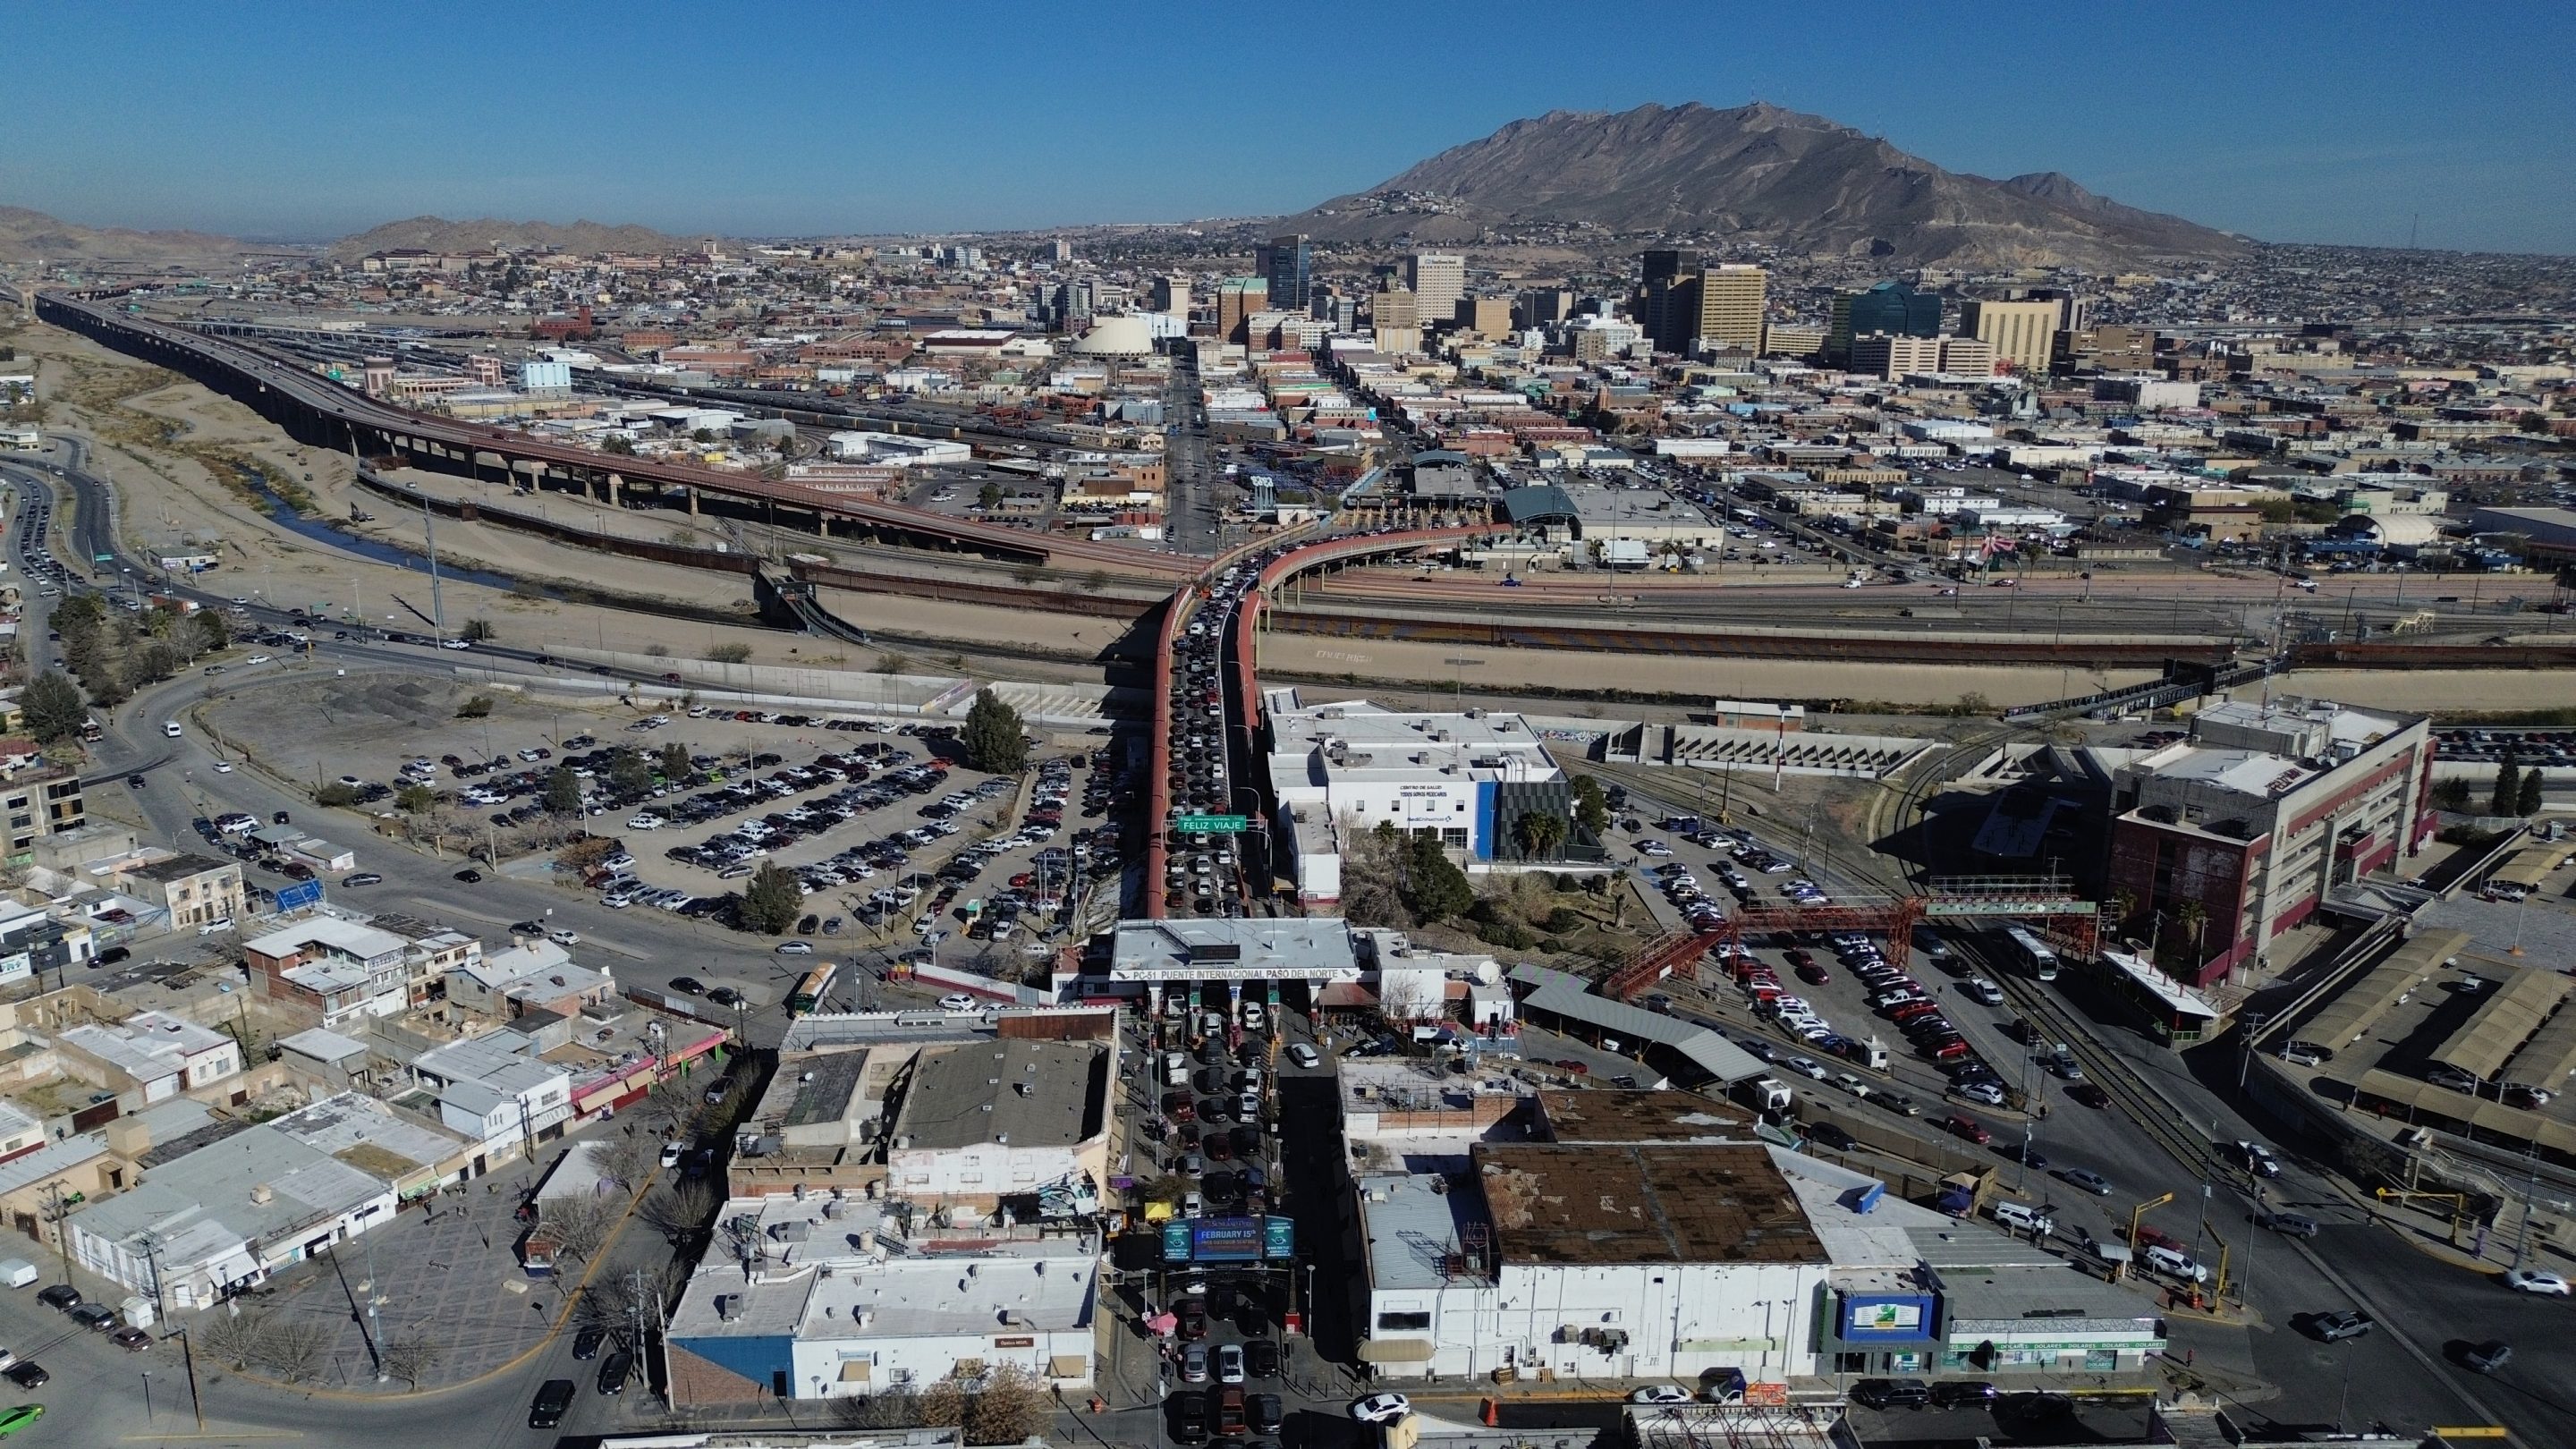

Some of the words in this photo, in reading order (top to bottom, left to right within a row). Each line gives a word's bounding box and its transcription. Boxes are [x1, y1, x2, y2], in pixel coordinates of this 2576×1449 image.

[1133, 971, 1157, 980] PC-51
[1162, 970, 1195, 980] PUENTE
[1197, 970, 1264, 979] INTERNACIONAL
[1267, 970, 1290, 979] PASO
[1291, 970, 1308, 979] DEL
[1309, 970, 1338, 979] NORTE
[1201, 1231, 1242, 1239] FEBRUARY
[1243, 1229, 1257, 1238] 15th
